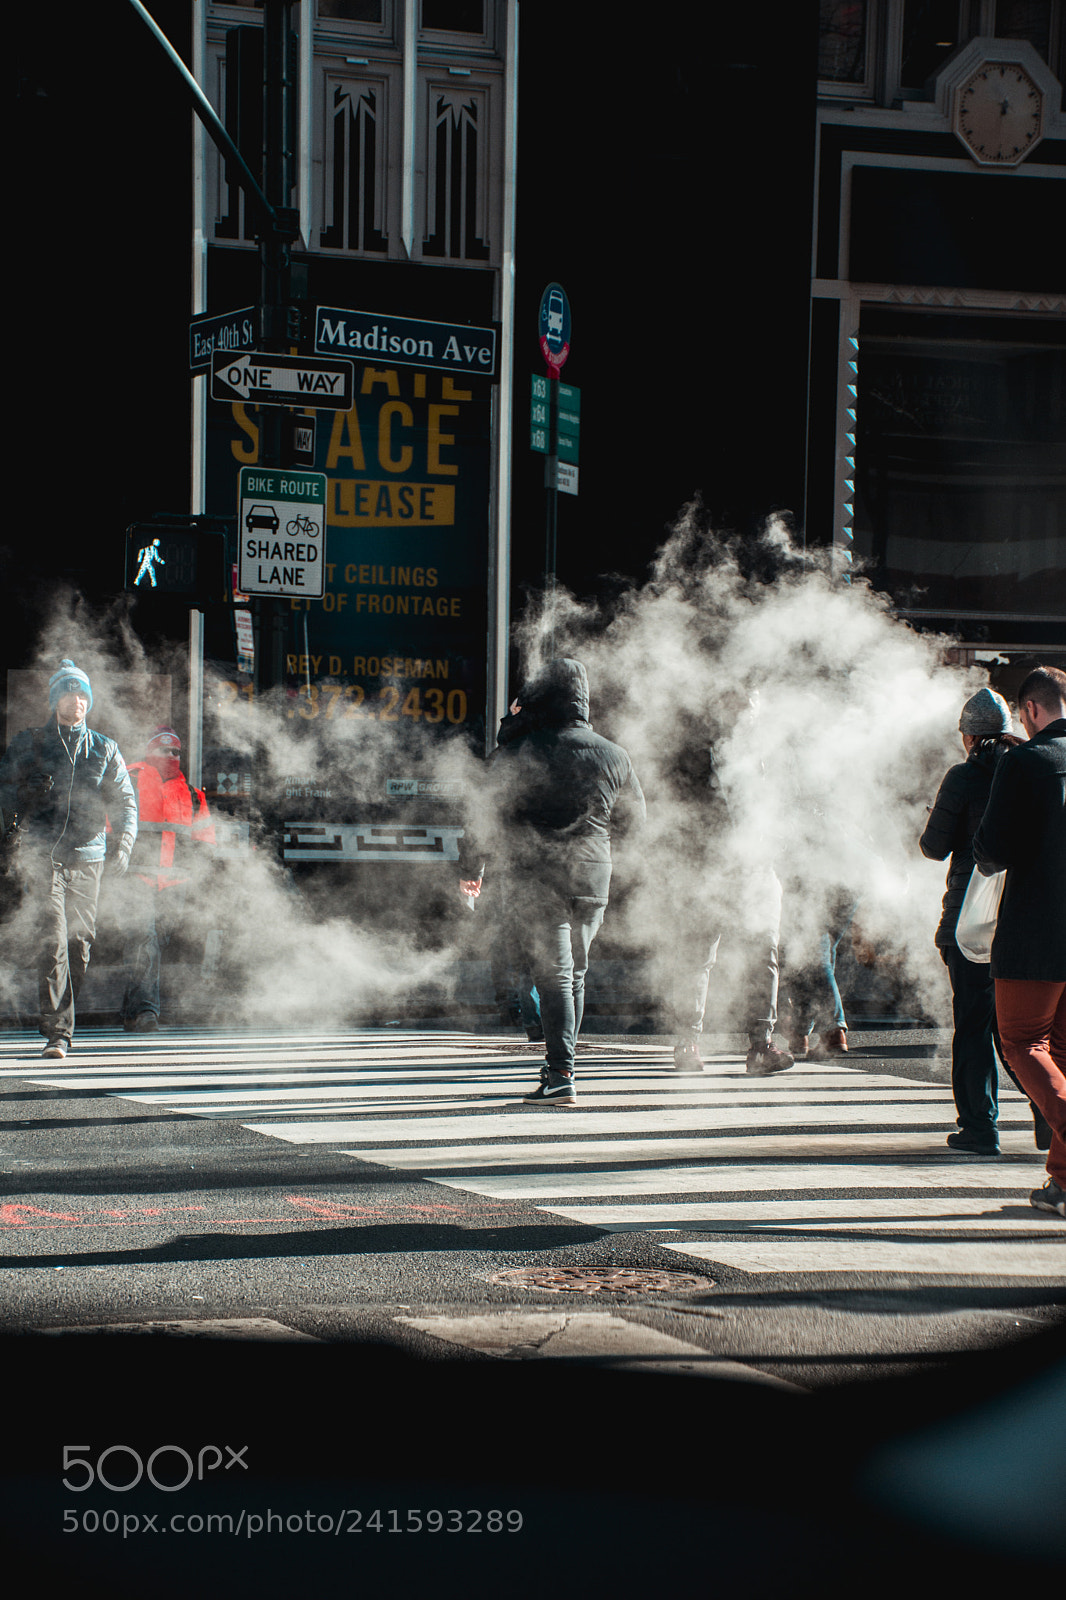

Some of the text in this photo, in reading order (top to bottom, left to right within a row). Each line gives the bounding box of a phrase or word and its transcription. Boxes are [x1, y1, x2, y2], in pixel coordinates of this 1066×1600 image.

[194, 319, 253, 359] East 40th St
[318, 318, 492, 366] Madison Ave
[227, 366, 272, 388] ONE
[297, 372, 341, 393] WAY
[231, 399, 459, 476] SACE
[296, 428, 312, 451] WAY
[247, 476, 320, 498] BIKE ROUTE
[334, 482, 436, 520] LEASE
[246, 539, 318, 563] SHARED
[257, 565, 306, 587] LANE
[344, 563, 440, 588] CEILINGS
[322, 592, 348, 613] OF
[355, 593, 462, 618] FRONTAGE
[329, 655, 348, 677] D.
[353, 655, 450, 680] ROSEMAN
